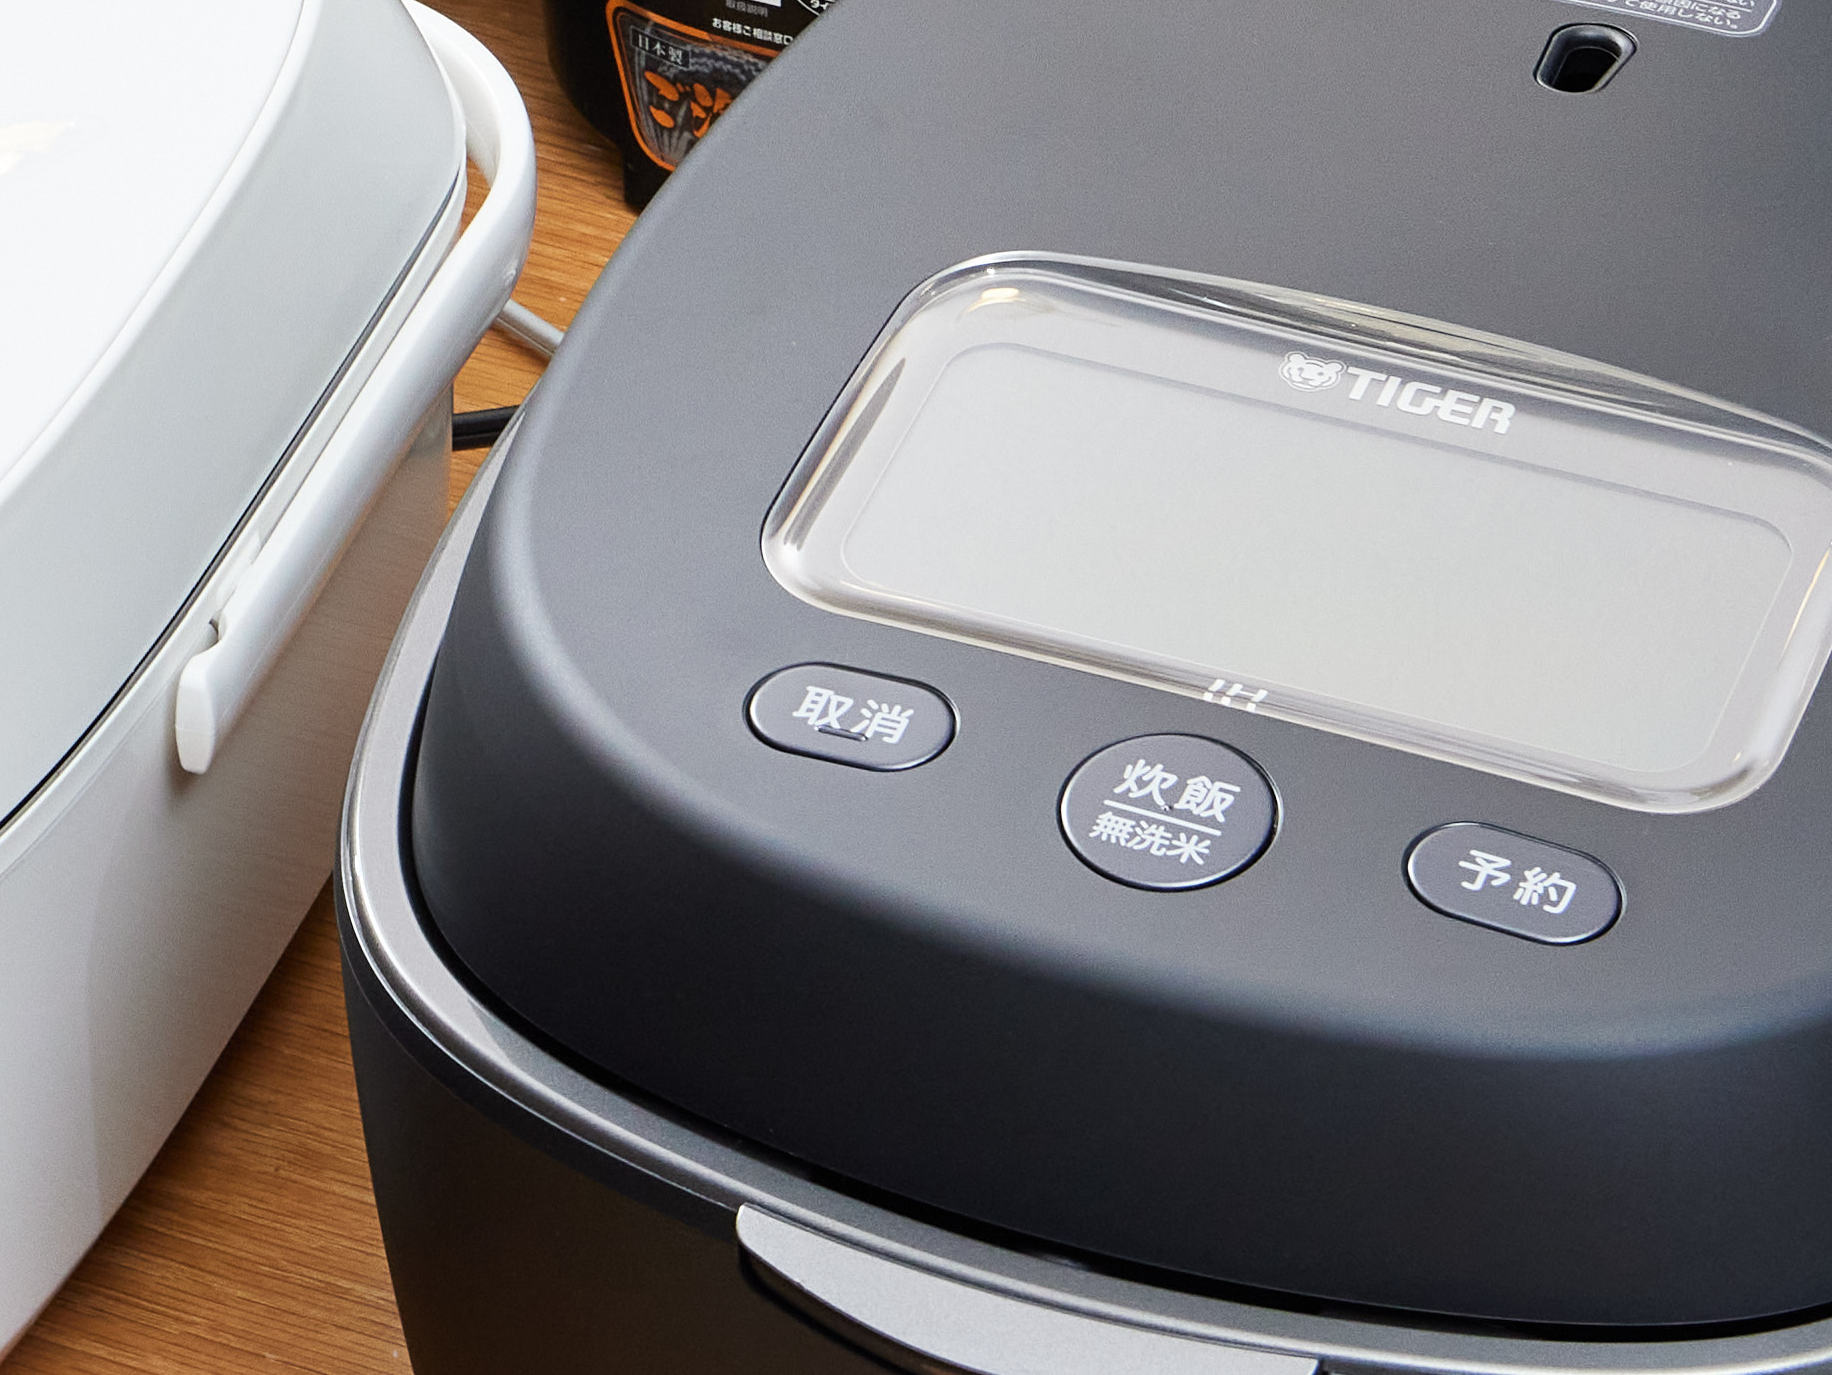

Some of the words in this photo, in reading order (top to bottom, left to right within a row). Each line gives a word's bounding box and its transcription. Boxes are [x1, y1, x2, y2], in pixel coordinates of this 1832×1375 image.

[637, 35, 684, 66] 日本製
[1347, 366, 1516, 435] TIGER
[793, 686, 913, 744] 取消
[1113, 758, 1242, 824] 炊飯
[1088, 811, 1212, 866] 無洗米
[1458, 848, 1578, 915] 予約
